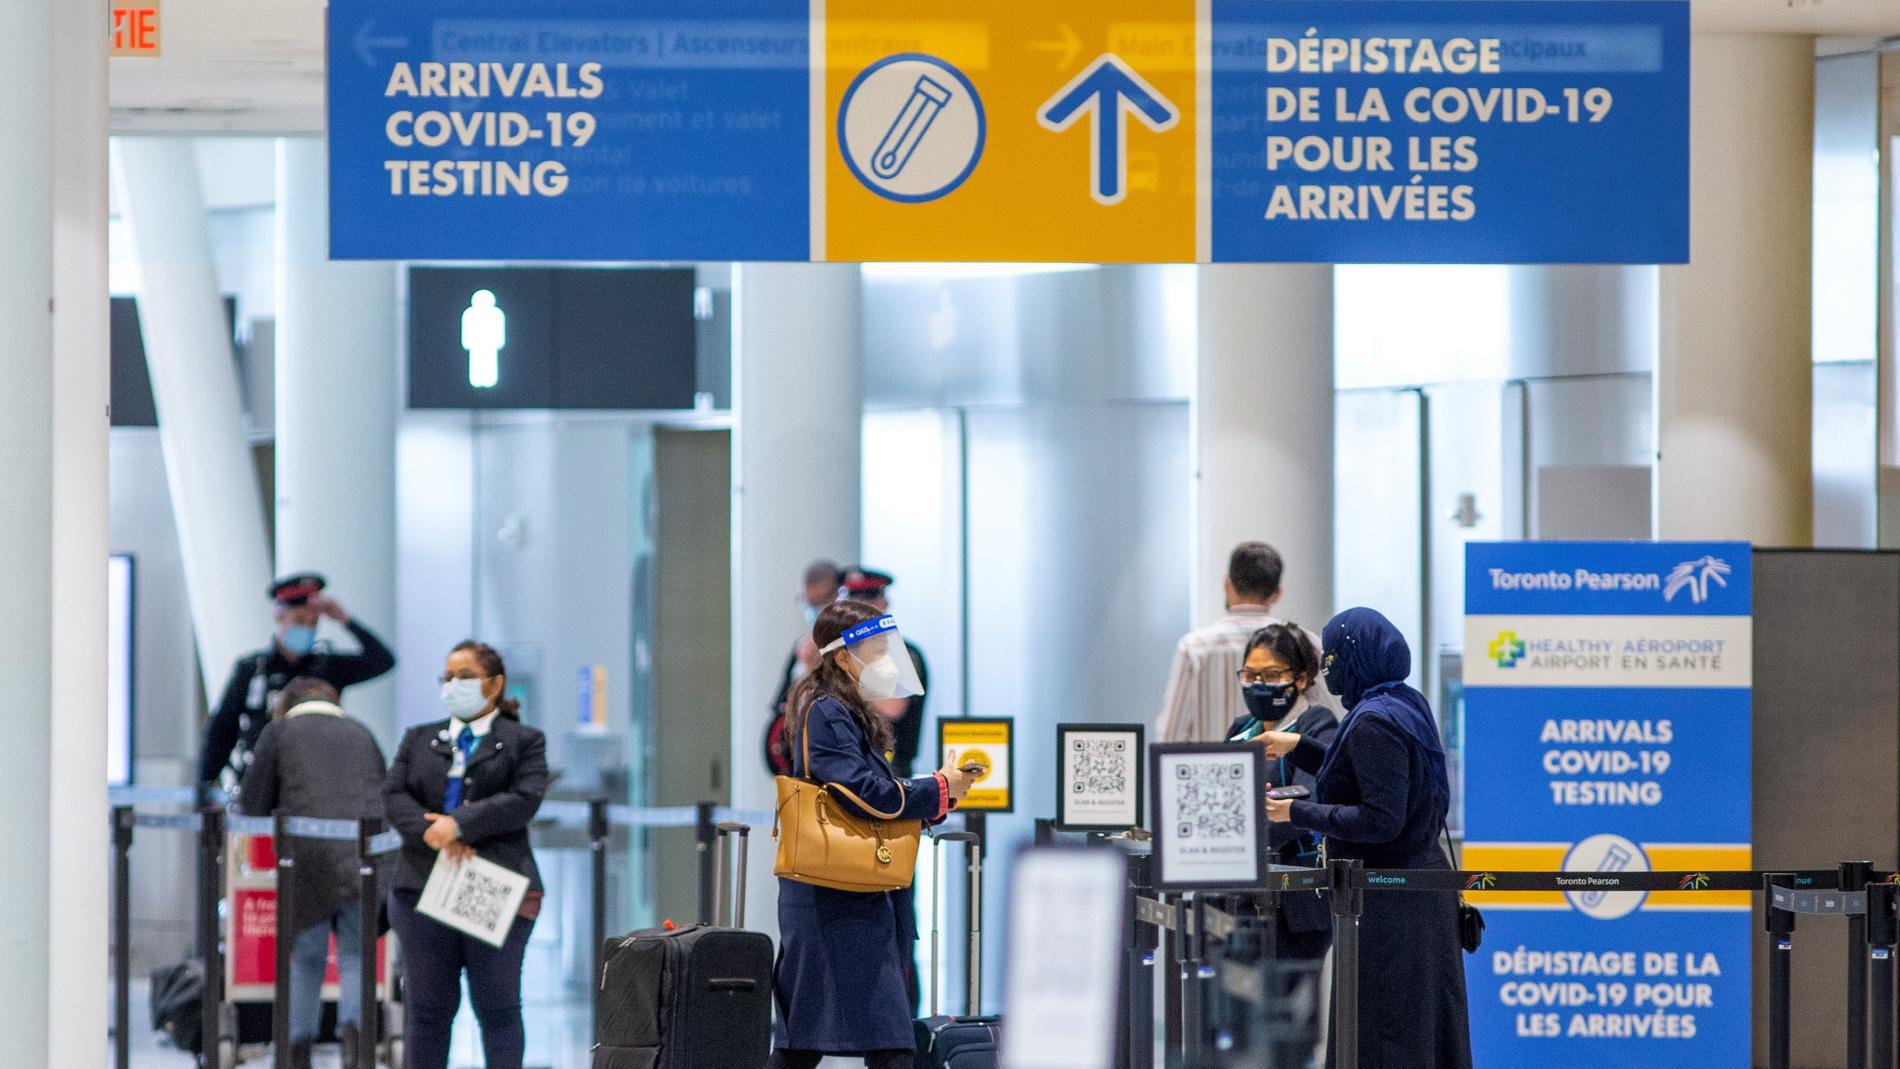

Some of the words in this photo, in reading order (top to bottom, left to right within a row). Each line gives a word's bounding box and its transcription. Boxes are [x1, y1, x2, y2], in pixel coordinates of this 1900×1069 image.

[114, 8, 156, 49] TIE
[1266, 27, 1501, 74] DÉPISTAGE
[384, 62, 604, 99] ARRIVALS
[1267, 87, 1320, 122] DE
[1336, 87, 1391, 122] LA
[1404, 87, 1613, 122] COVID-19
[385, 110, 597, 147] COVID-19
[1267, 136, 1394, 171] POUR
[1408, 136, 1479, 171] LES
[384, 160, 569, 197] TESTING
[1265, 174, 1476, 221] ARRIVÉES
[1489, 568, 1572, 590] Toronto
[1575, 569, 1660, 590] Pearson
[1529, 639, 1613, 652] HEALTHY
[1623, 637, 1726, 653] AÉROPORT
[1531, 655, 1611, 669] AIRPORT
[1622, 655, 1648, 670] EN
[1656, 652, 1722, 671] SANTÉ
[1540, 719, 1674, 744] ARRIVALS
[1543, 750, 1671, 775] COVID-19
[1550, 781, 1662, 806] TESTING
[1368, 873, 1407, 884] welcome
[1556, 877, 1587, 886] Toronto
[1587, 877, 1620, 886] Pearson
[1796, 877, 1812, 885] nue
[1493, 944, 1636, 976] DÉPISTAGE
[1642, 952, 1678, 976] DE
[1685, 952, 1721, 976] LA
[1499, 981, 1628, 1007] COVID-19
[1633, 983, 1713, 1008] POUR
[1516, 1013, 1561, 1037] LES
[1567, 1007, 1697, 1038] ARRIVÉES
